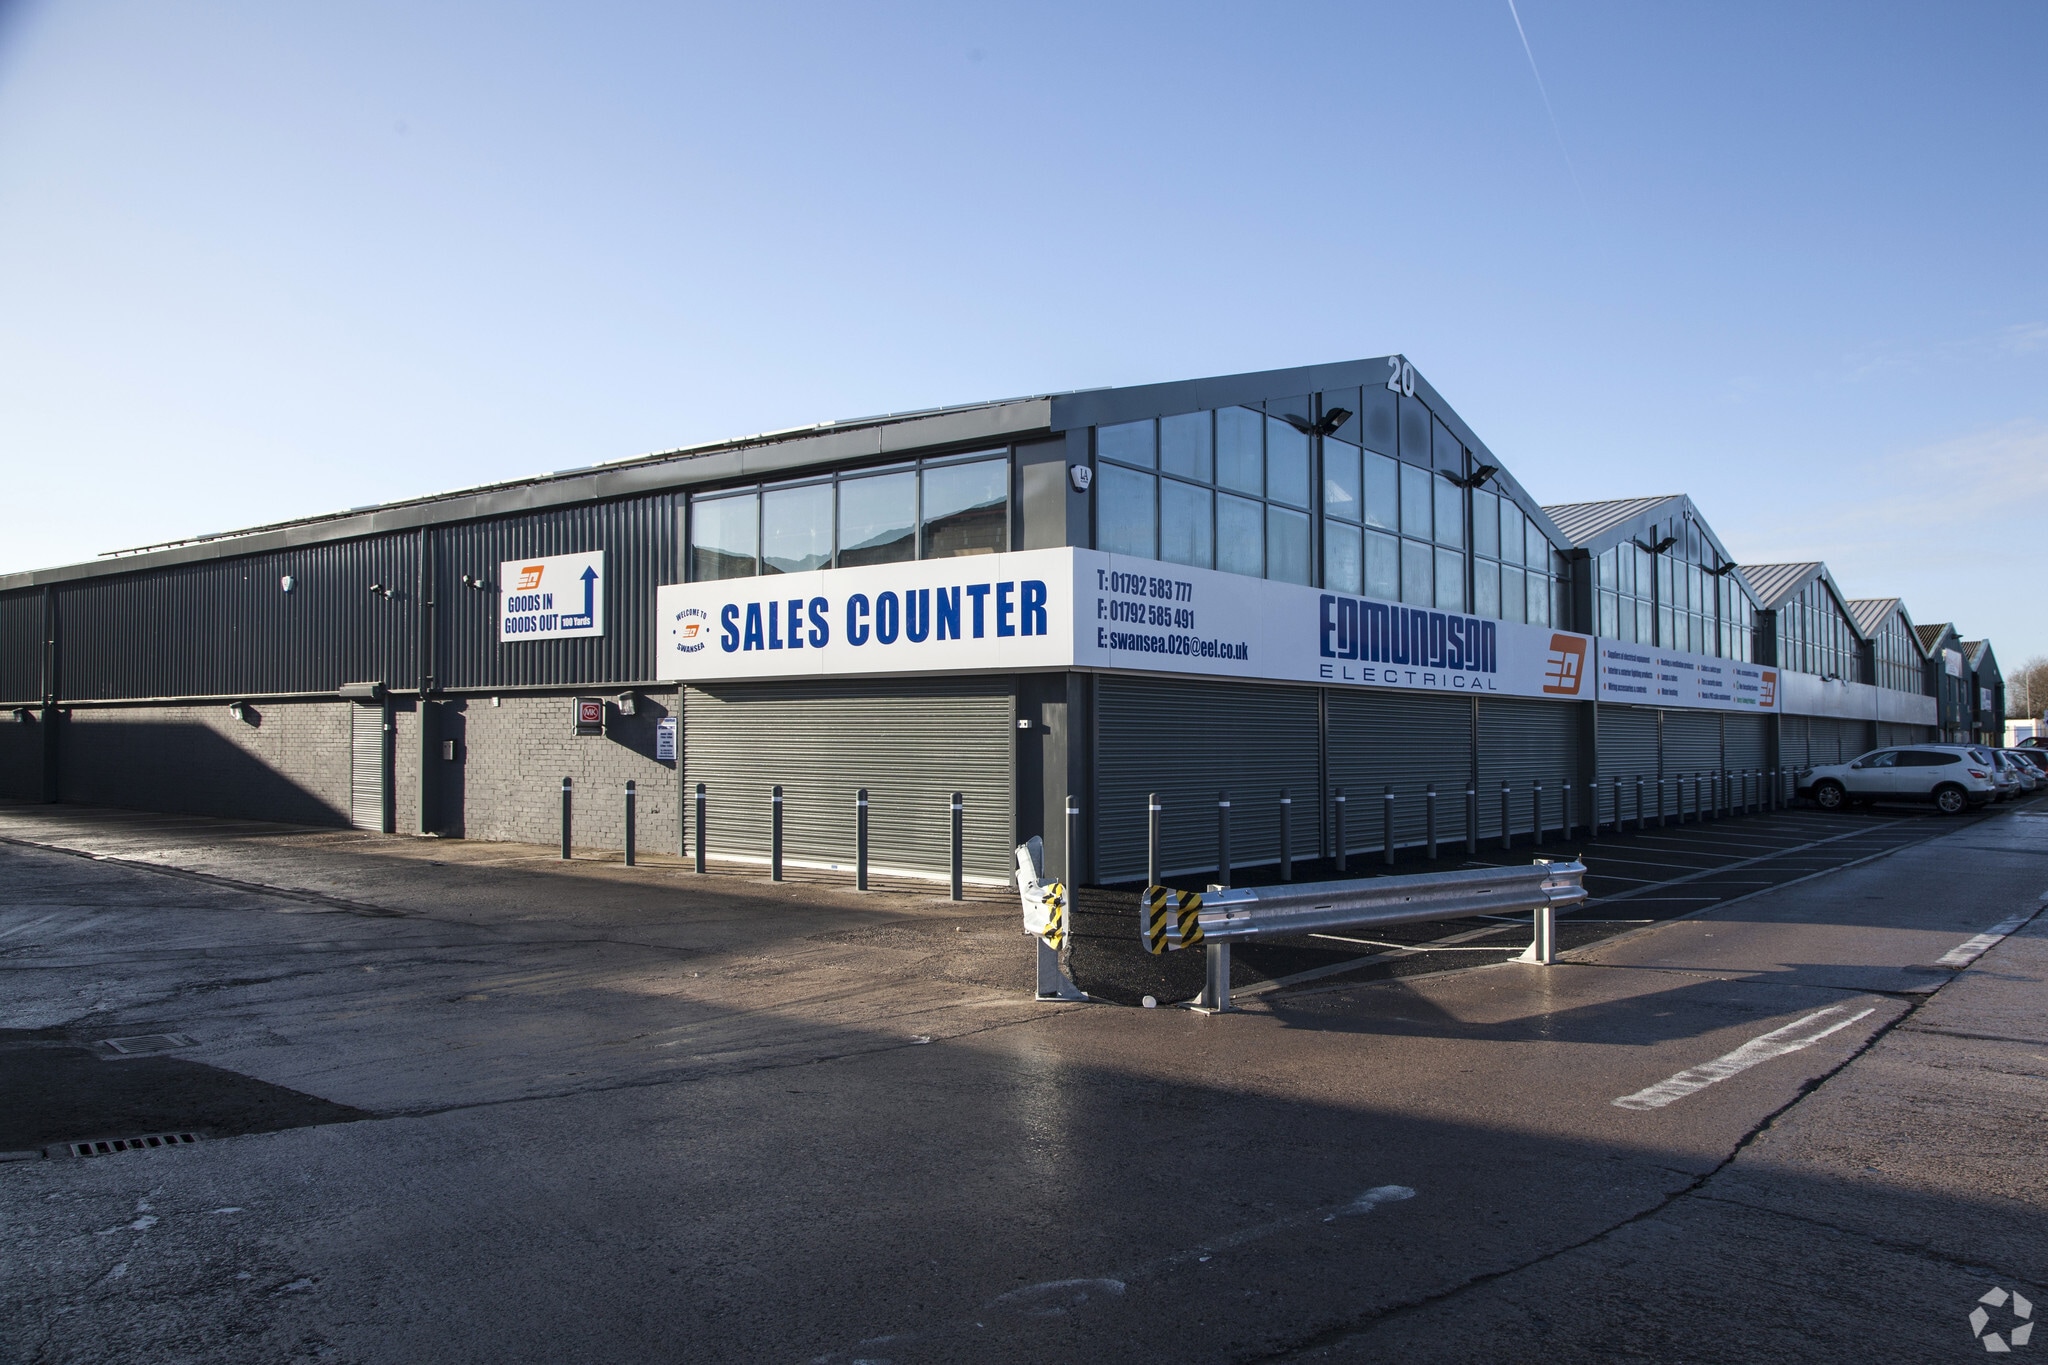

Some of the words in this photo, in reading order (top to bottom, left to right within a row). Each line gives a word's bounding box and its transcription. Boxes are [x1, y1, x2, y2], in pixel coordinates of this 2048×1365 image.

[1388, 356, 1414, 397] 20
[1097, 569, 1109, 591] T:
[1111, 571, 1147, 596] 01792
[1149, 577, 1172, 600] 583
[1175, 581, 1192, 602] 777
[508, 594, 540, 613] GOODS
[543, 593, 553, 610] IN
[676, 608, 700, 621] WELCOME
[700, 610, 707, 620] TO
[720, 596, 829, 653] SALES
[846, 579, 1048, 647] COUNTER
[1097, 598, 1108, 620] F:
[1110, 600, 1146, 625] 01792
[1148, 605, 1172, 627] 585
[1174, 608, 1195, 630] 491
[505, 615, 537, 634] GOODS
[539, 613, 559, 631] OUT
[562, 617, 573, 627] 100
[574, 616, 591, 626] Yards
[677, 642, 705, 653] SWANSEA
[1097, 627, 1108, 649] E:
[1109, 631, 1249, 661] swansea.026@eel.co.uk
[1320, 664, 1497, 690] ELECTRICAL
